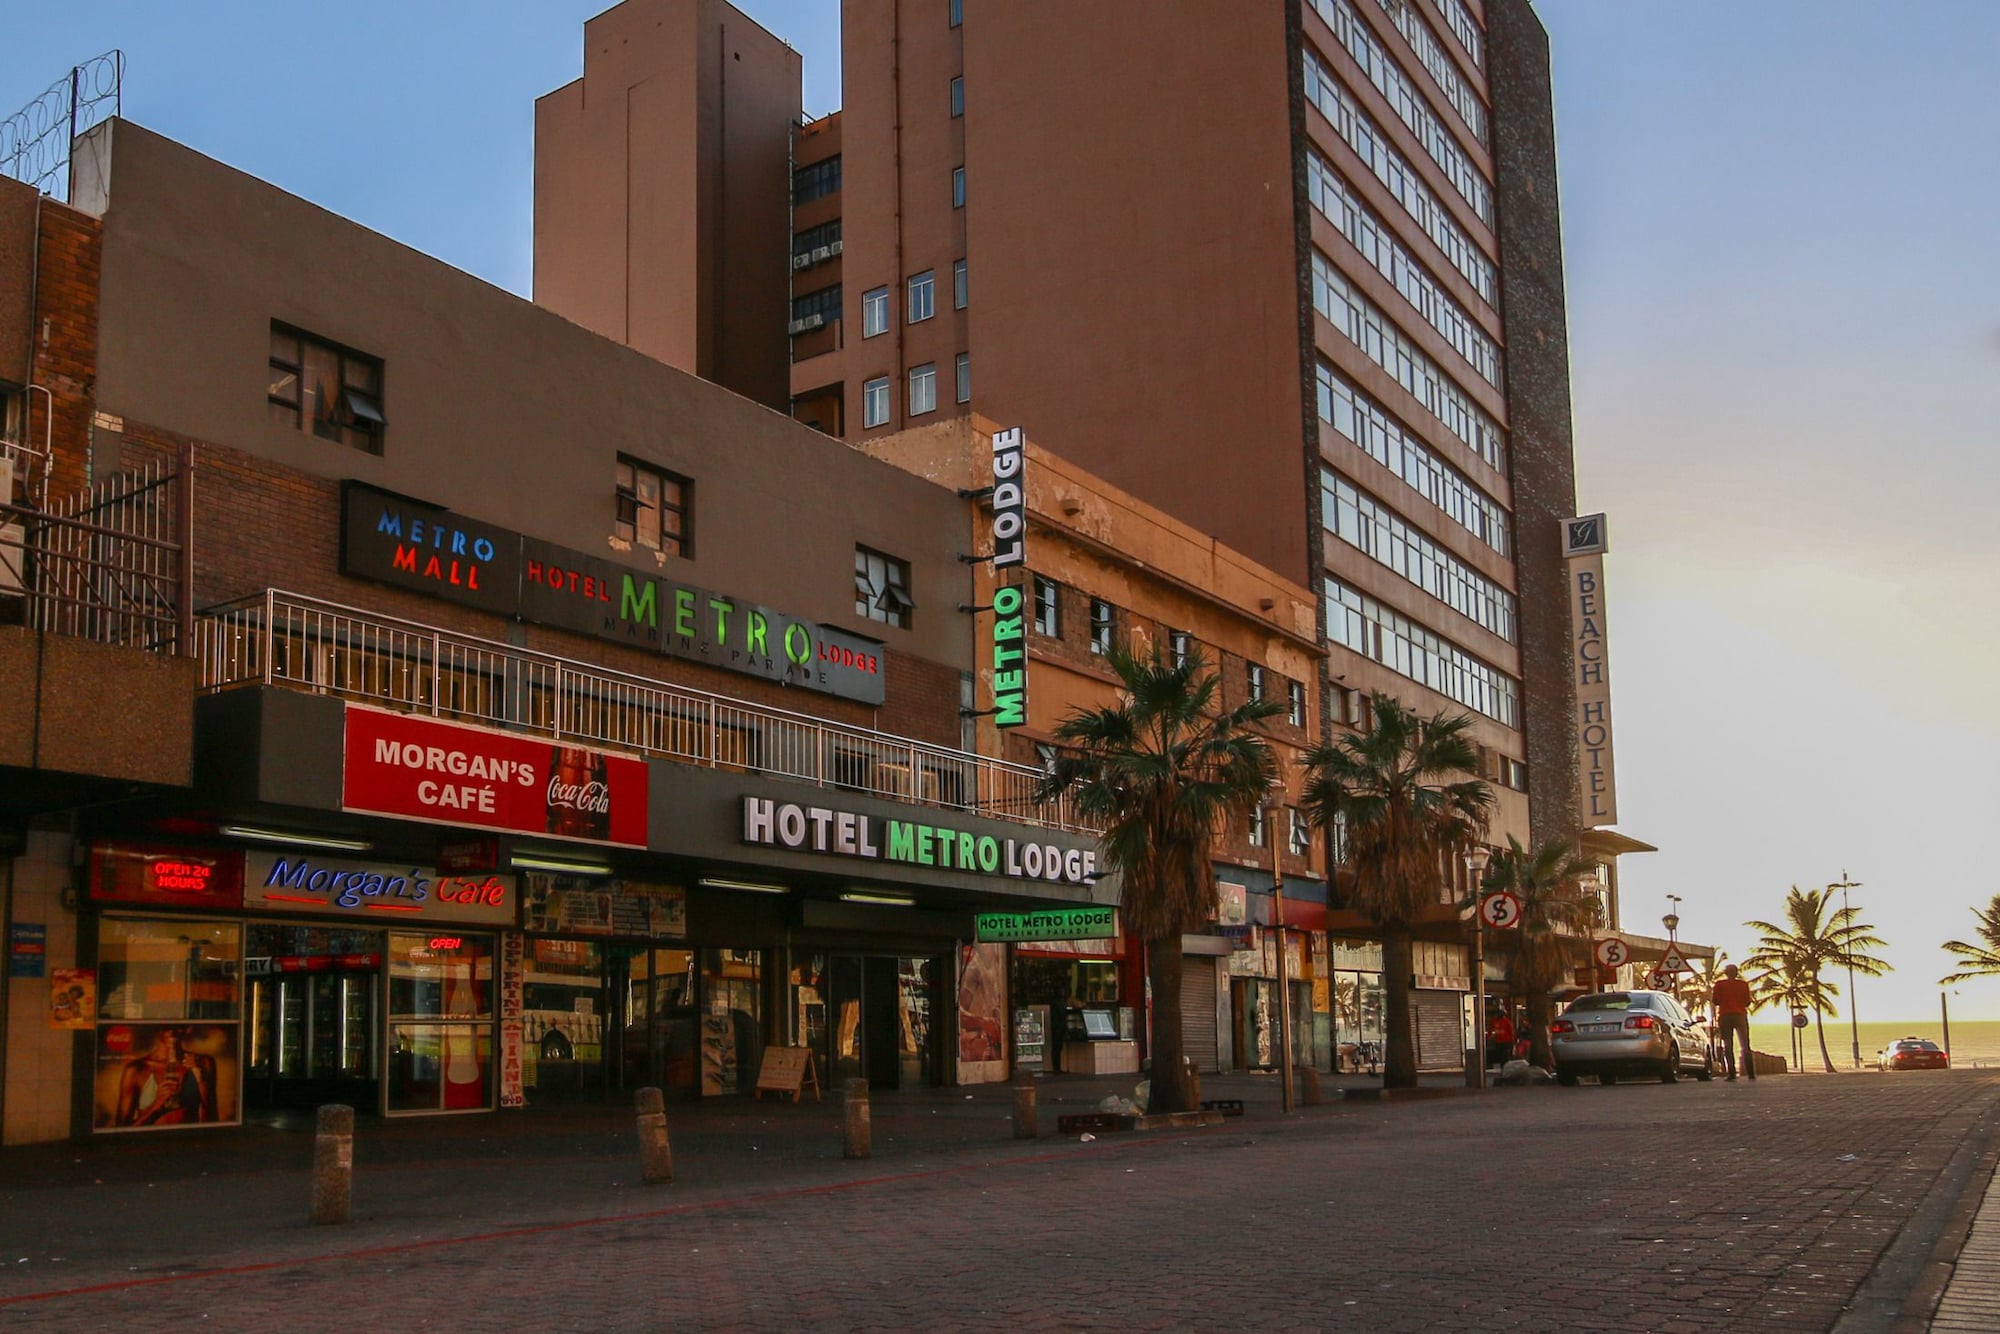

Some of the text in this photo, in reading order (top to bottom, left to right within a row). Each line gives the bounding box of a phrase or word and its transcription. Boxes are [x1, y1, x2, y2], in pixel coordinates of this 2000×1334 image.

[992, 426, 1023, 566] LODGE
[377, 506, 495, 562] METRO
[392, 543, 480, 591] MALL
[527, 559, 878, 676] HOTEL METRO LODGE
[604, 616, 827, 685] MARINE PARADE
[993, 586, 1024, 725] METRO
[1577, 571, 1608, 817] BEACH HOTEL
[375, 738, 536, 787] MORGAN'S
[418, 780, 496, 814] CAFÉ
[546, 774, 609, 814] Coca-Cola
[743, 795, 1097, 886] HOTEL METRO LODGE
[154, 862, 190, 876] OPEN
[158, 876, 206, 890] HOURS
[263, 856, 430, 908] Morgan's
[437, 876, 507, 907] Cafe
[430, 937, 463, 949] OPEN
[980, 913, 1112, 930] HOTEL METRO LODGE
[998, 929, 1040, 937] MARINE
